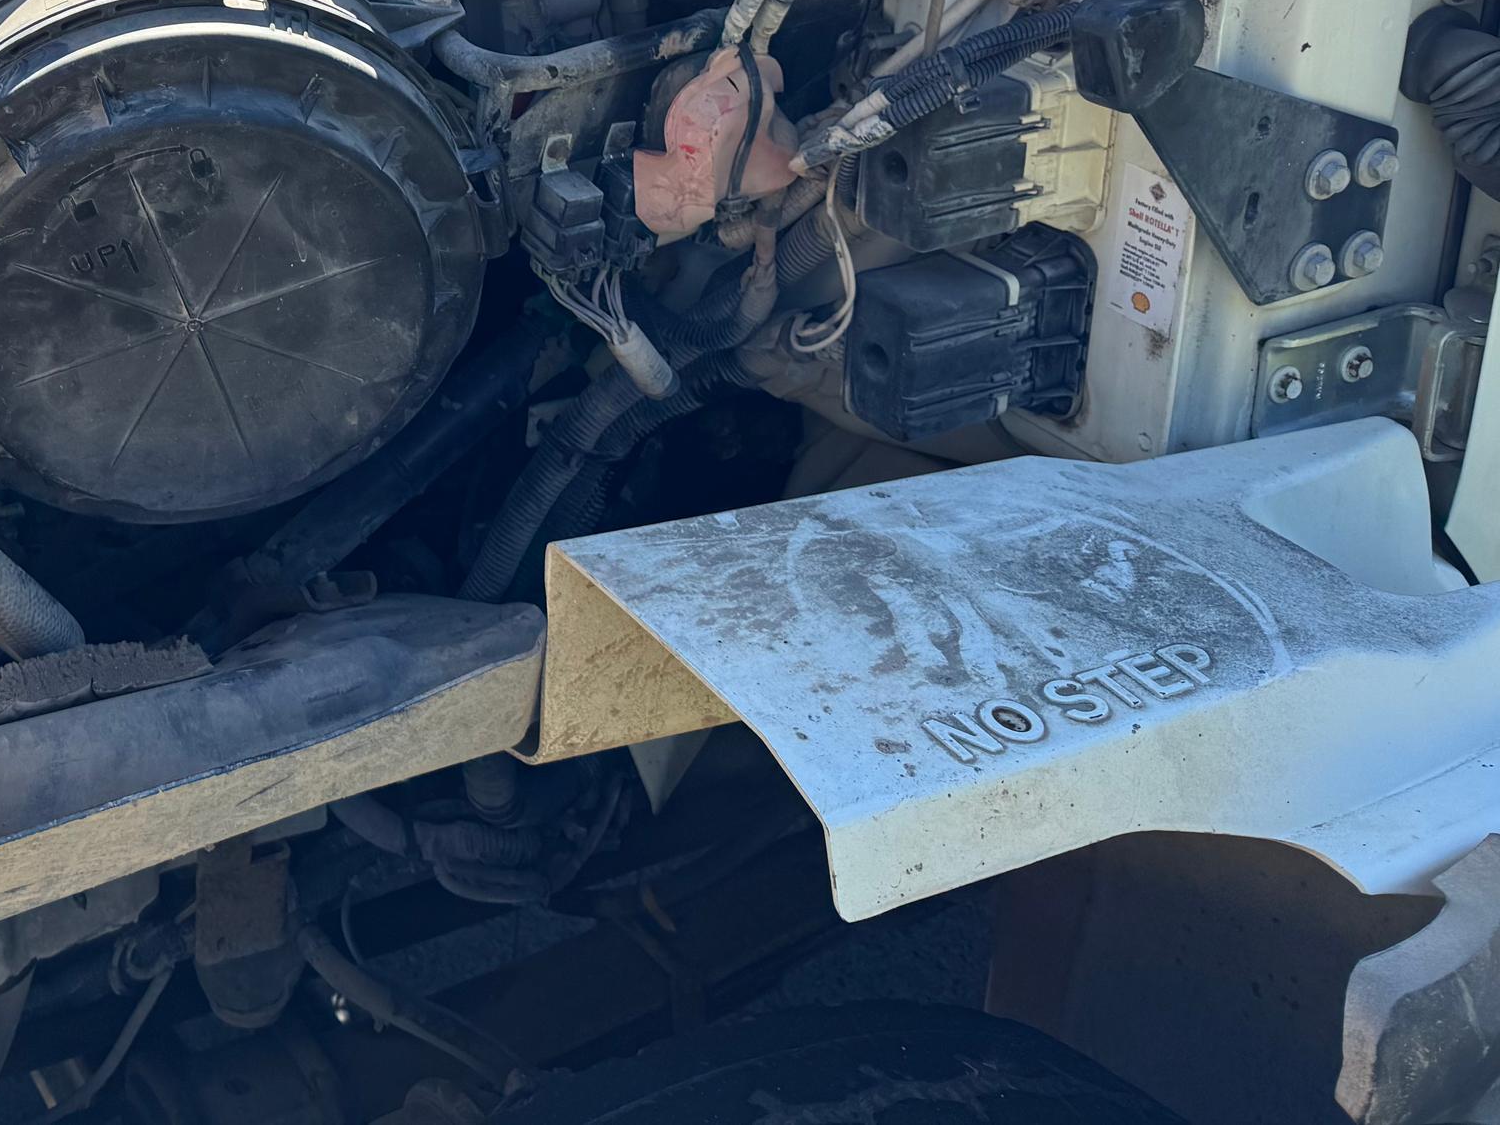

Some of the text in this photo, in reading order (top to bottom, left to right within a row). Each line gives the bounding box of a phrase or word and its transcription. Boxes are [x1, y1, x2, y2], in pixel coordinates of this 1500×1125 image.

[70, 243, 117, 273] UP
[921, 642, 1213, 766] NO STEP
